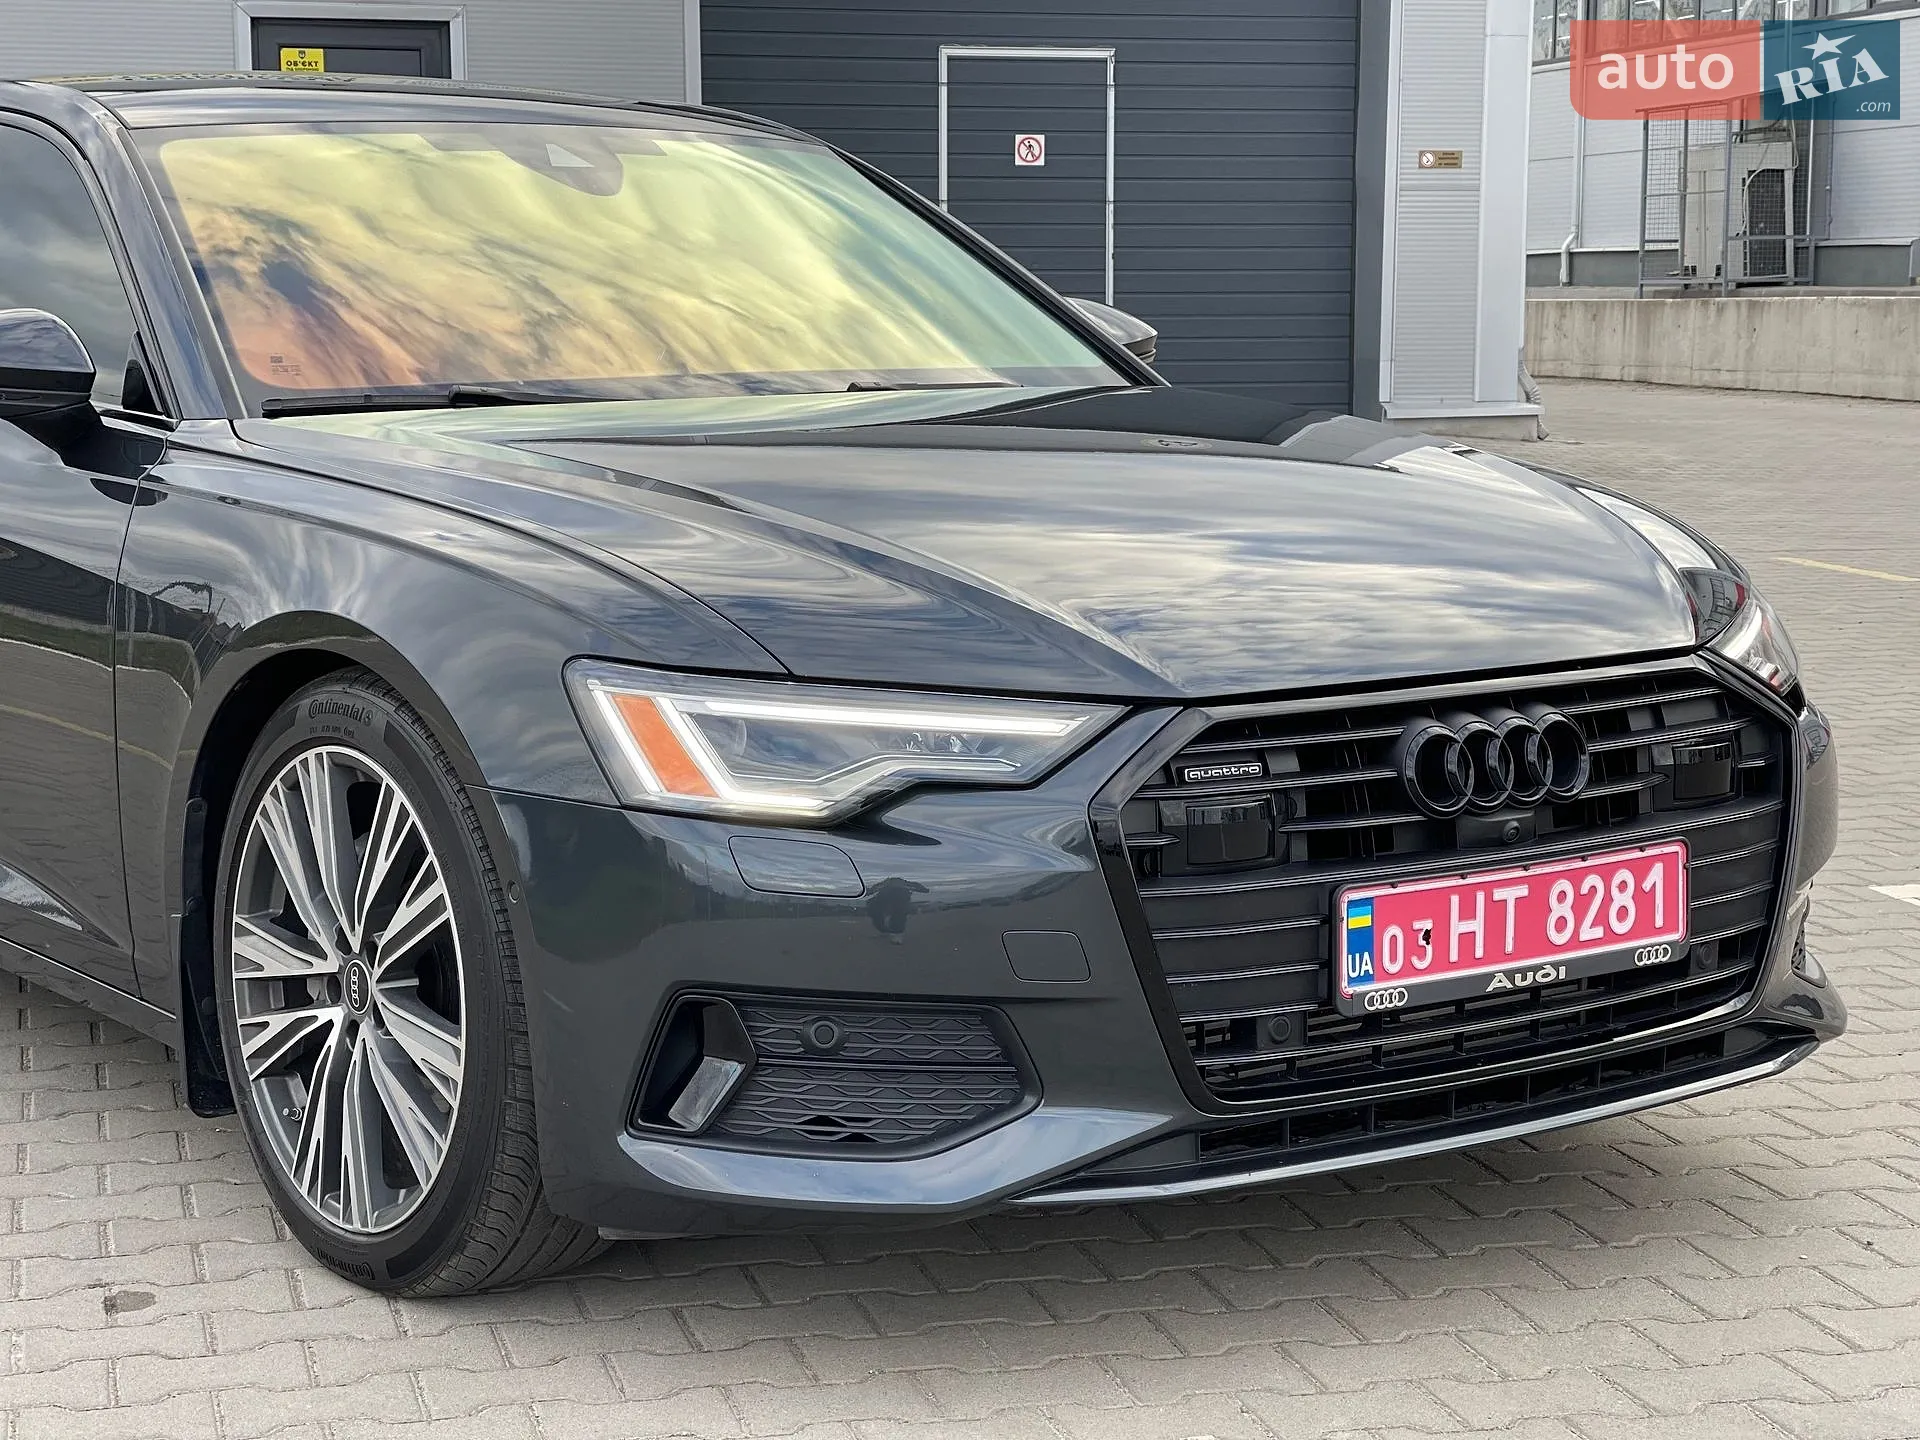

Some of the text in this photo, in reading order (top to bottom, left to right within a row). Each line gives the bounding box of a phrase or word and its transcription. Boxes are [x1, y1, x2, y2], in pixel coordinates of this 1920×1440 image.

[308, 699, 365, 723] Continental
[1189, 765, 1260, 780] quattro
[1382, 862, 1665, 975] 03 HT 8281
[1347, 951, 1374, 979] UA
[1485, 965, 1568, 993] Audi
